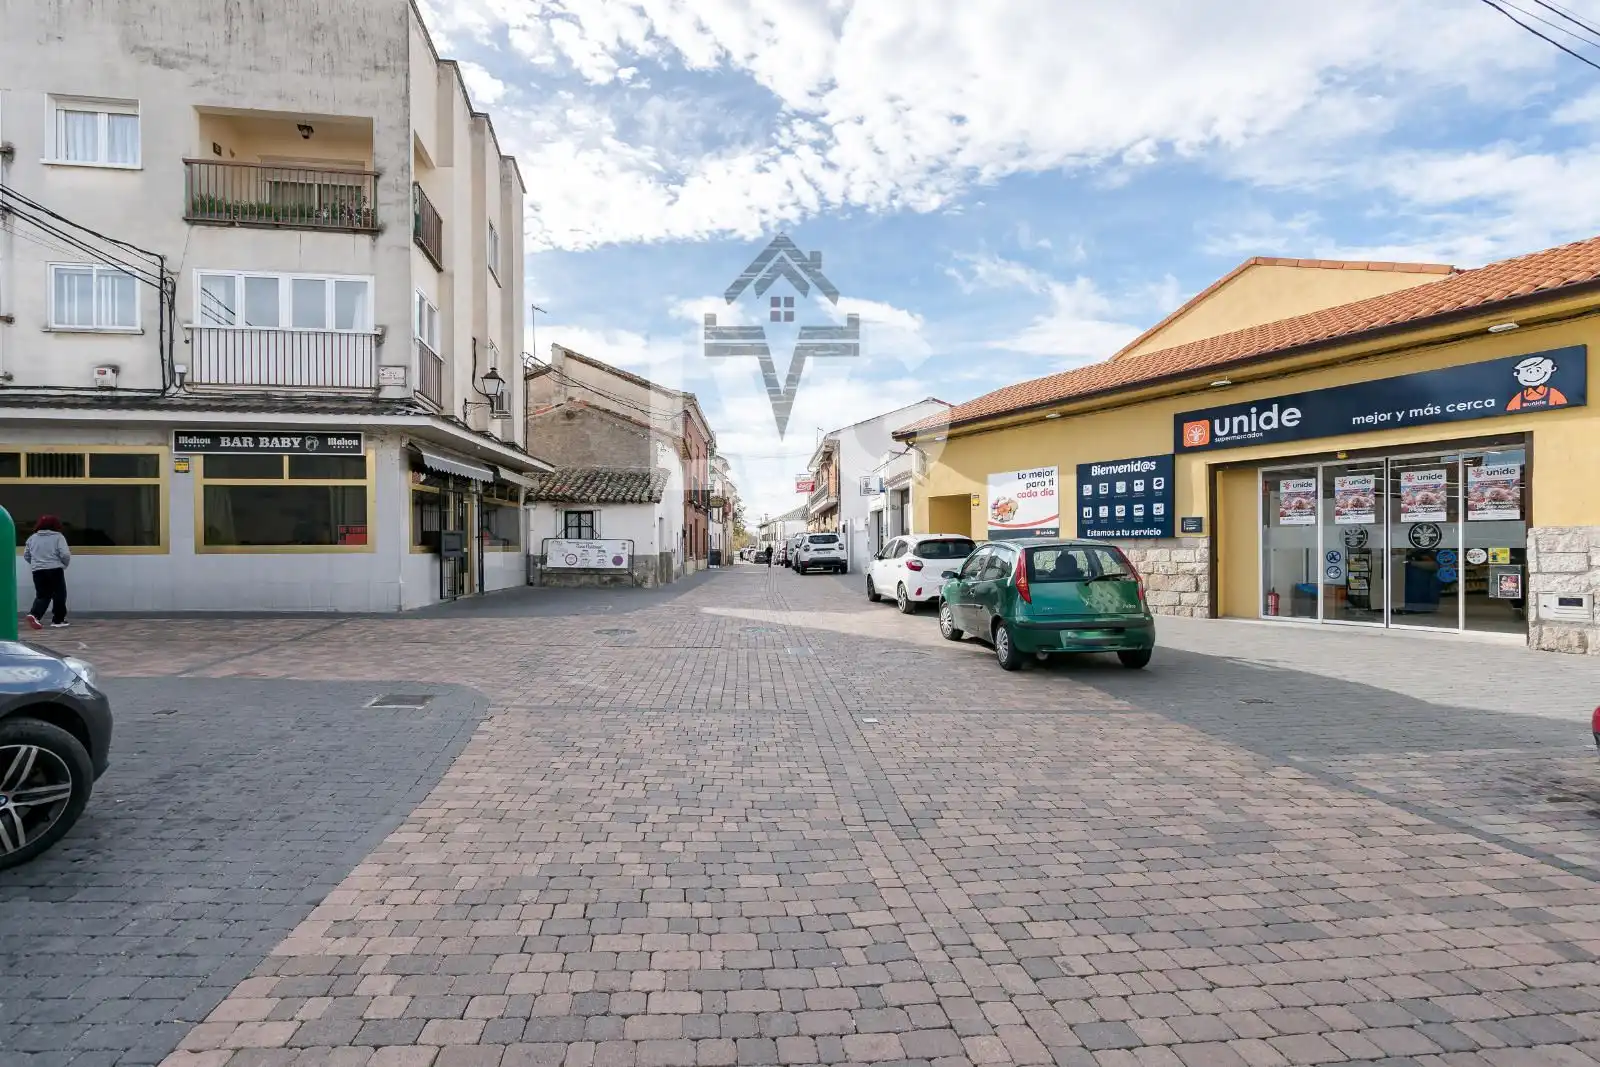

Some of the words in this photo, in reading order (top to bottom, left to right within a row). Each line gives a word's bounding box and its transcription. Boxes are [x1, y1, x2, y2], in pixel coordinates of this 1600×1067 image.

[1352, 411, 1392, 425] mejor
[1396, 409, 1405, 421] y
[1409, 403, 1441, 418] más
[1446, 398, 1496, 413] cerca
[1214, 403, 1302, 436] unide
[178, 435, 211, 445] Mahou
[219, 436, 255, 448] BAR
[258, 436, 302, 448] BABY
[327, 437, 359, 446] Mahou
[1215, 432, 1263, 443] supermercados
[1091, 461, 1157, 476] Bienvenid@s
[1486, 467, 1516, 476] unide
[1017, 472, 1027, 480] Lo
[1029, 469, 1054, 478] mejor
[1417, 473, 1443, 481] unide
[1026, 480, 1046, 490] para
[1048, 478, 1054, 486] ti
[1017, 490, 1038, 498] cada
[1040, 488, 1054, 497] día
[1087, 529, 1115, 537] Estamos
[1131, 527, 1162, 536] servicio
